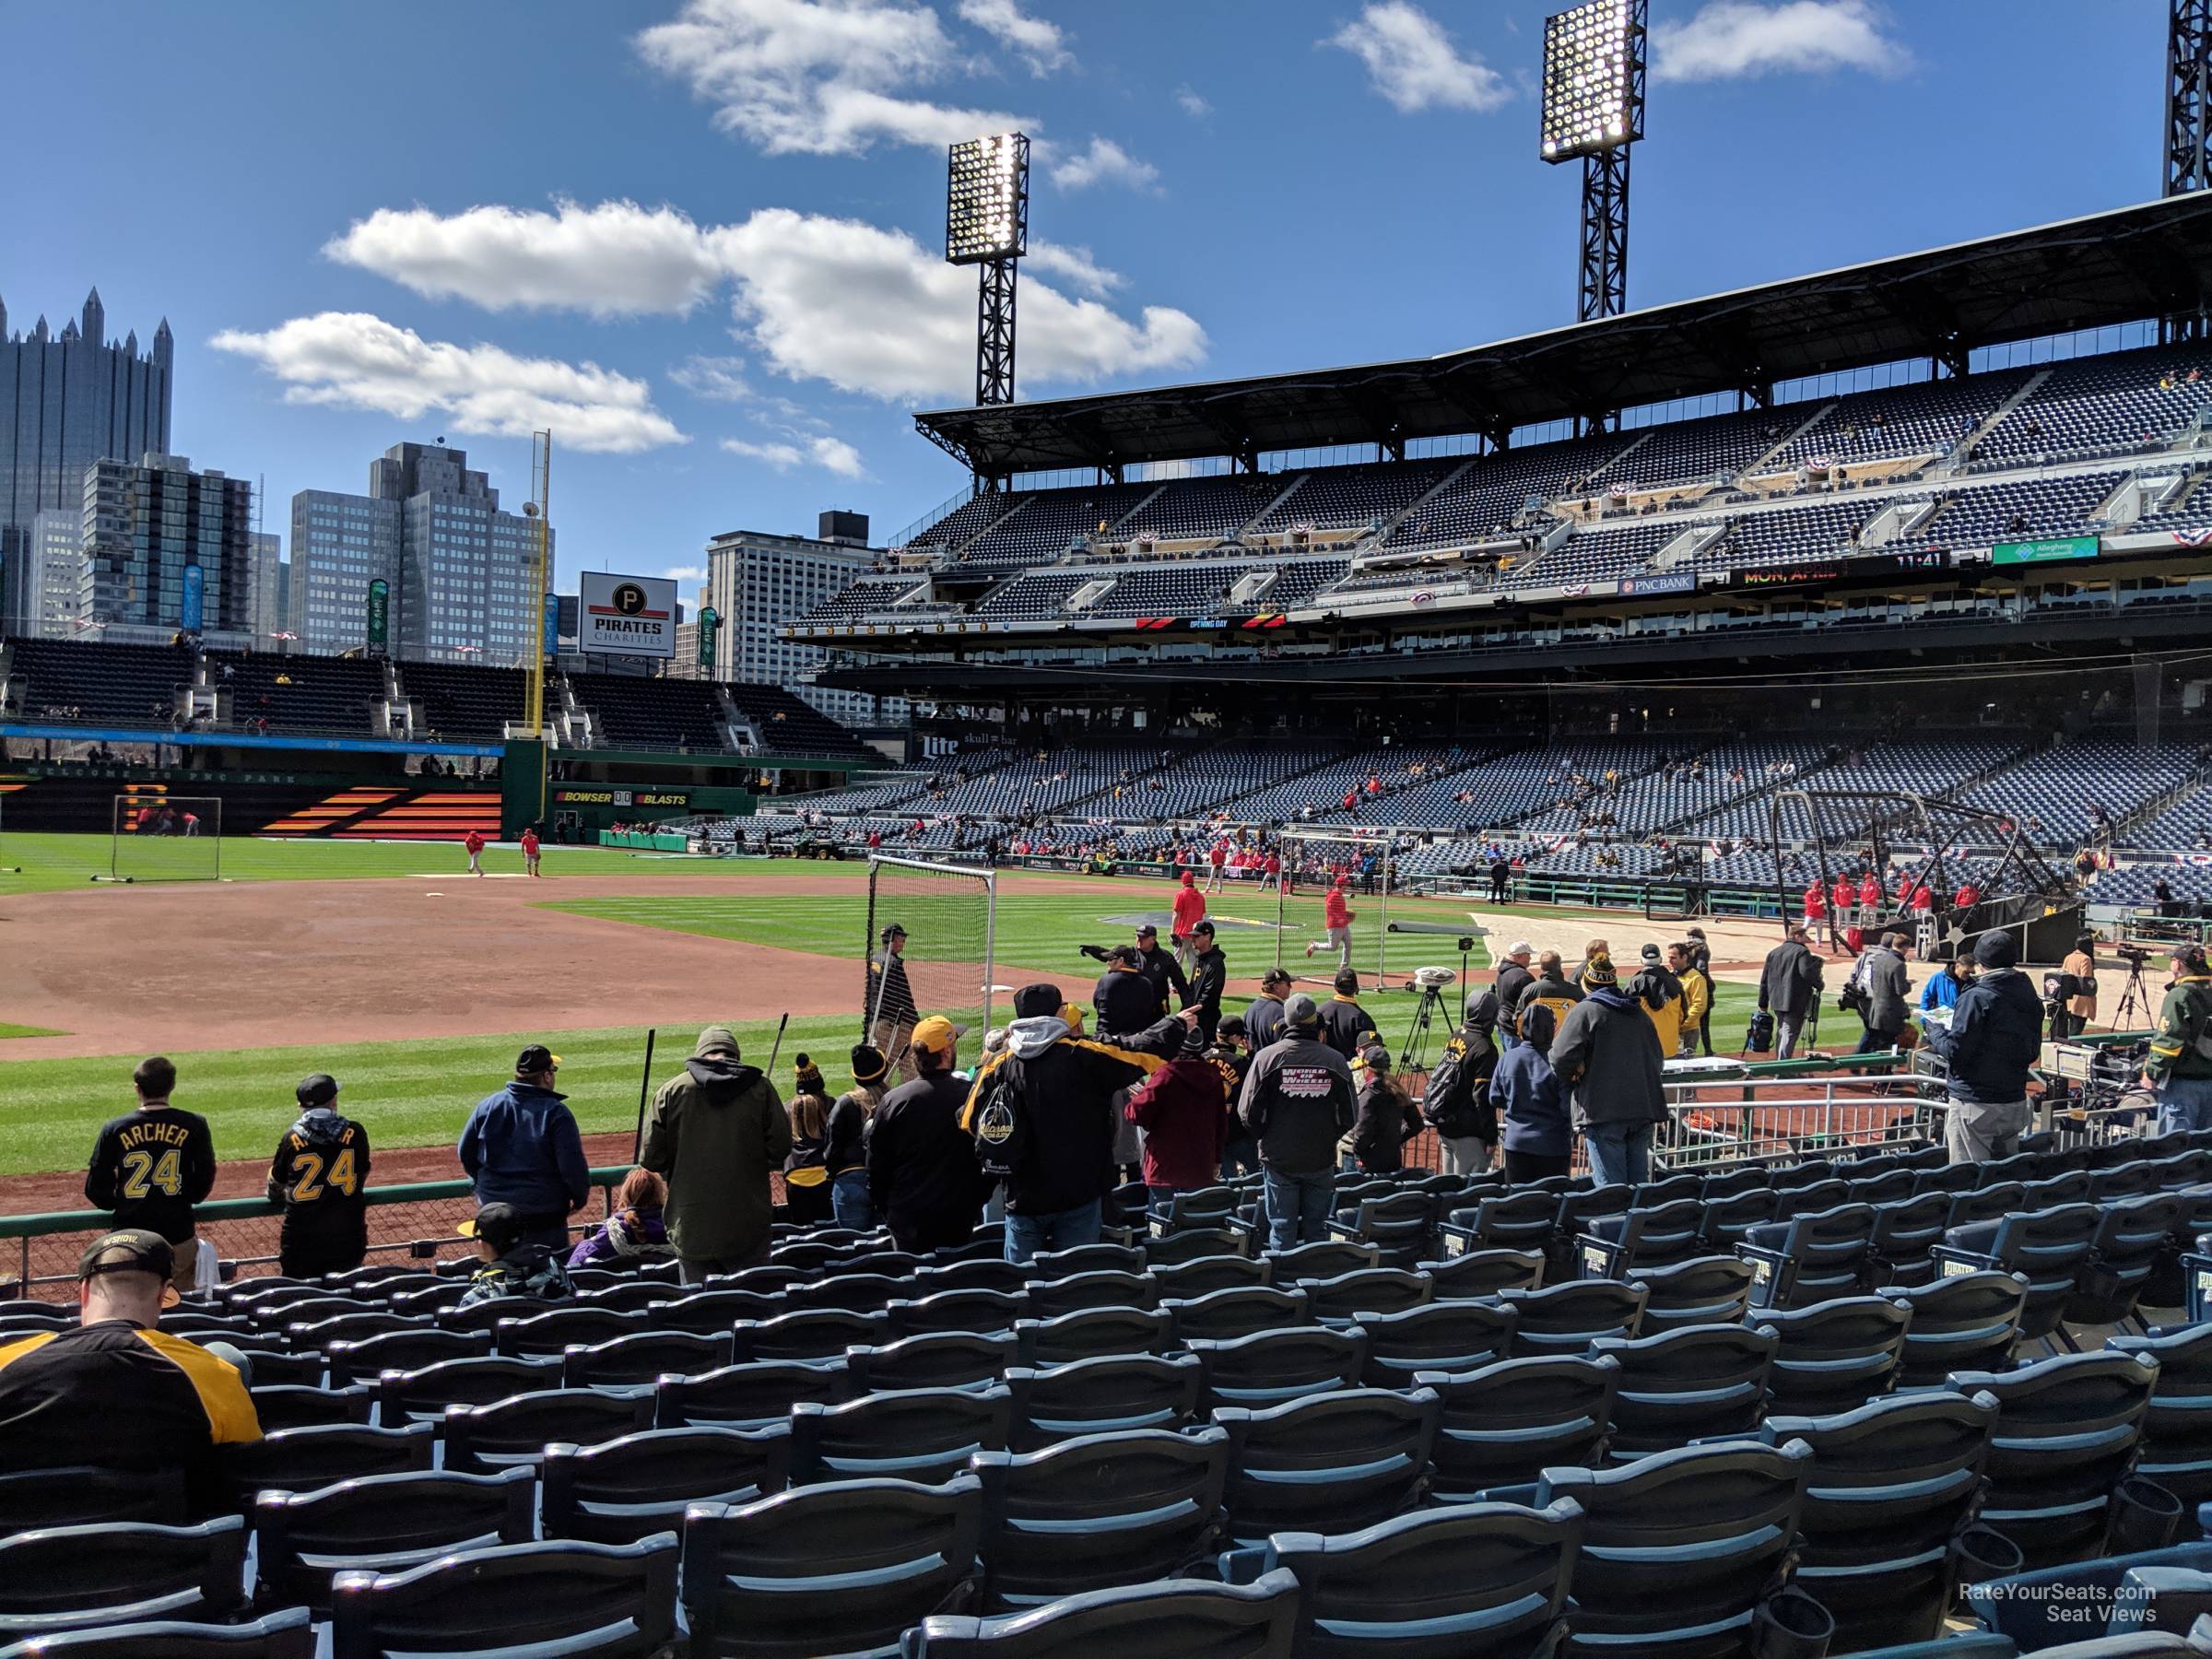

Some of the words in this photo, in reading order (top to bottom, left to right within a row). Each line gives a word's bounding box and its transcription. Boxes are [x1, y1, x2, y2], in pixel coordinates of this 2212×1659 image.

[2036, 543, 2073, 552] Allegheny
[1635, 580, 1659, 592] PNC
[1660, 577, 1690, 589] BANK
[623, 591, 637, 609] P
[595, 618, 662, 635] PIRATES
[1216, 619, 1228, 628] DAY
[594, 631, 662, 645] CHARITIES
[964, 733, 989, 744] skull
[922, 735, 959, 760] Lite
[29, 767, 131, 778] WELCOME
[149, 771, 171, 780] TO
[190, 771, 227, 782] PNC
[245, 773, 296, 783] PARK
[564, 792, 613, 803] BOWSER
[644, 794, 687, 805] BLASTS
[1194, 967, 1202, 982] P
[1369, 1031, 1376, 1040] P
[120, 1123, 190, 1150] ARCHER
[123, 1149, 182, 1198] 24
[292, 1148, 358, 1202] 24
